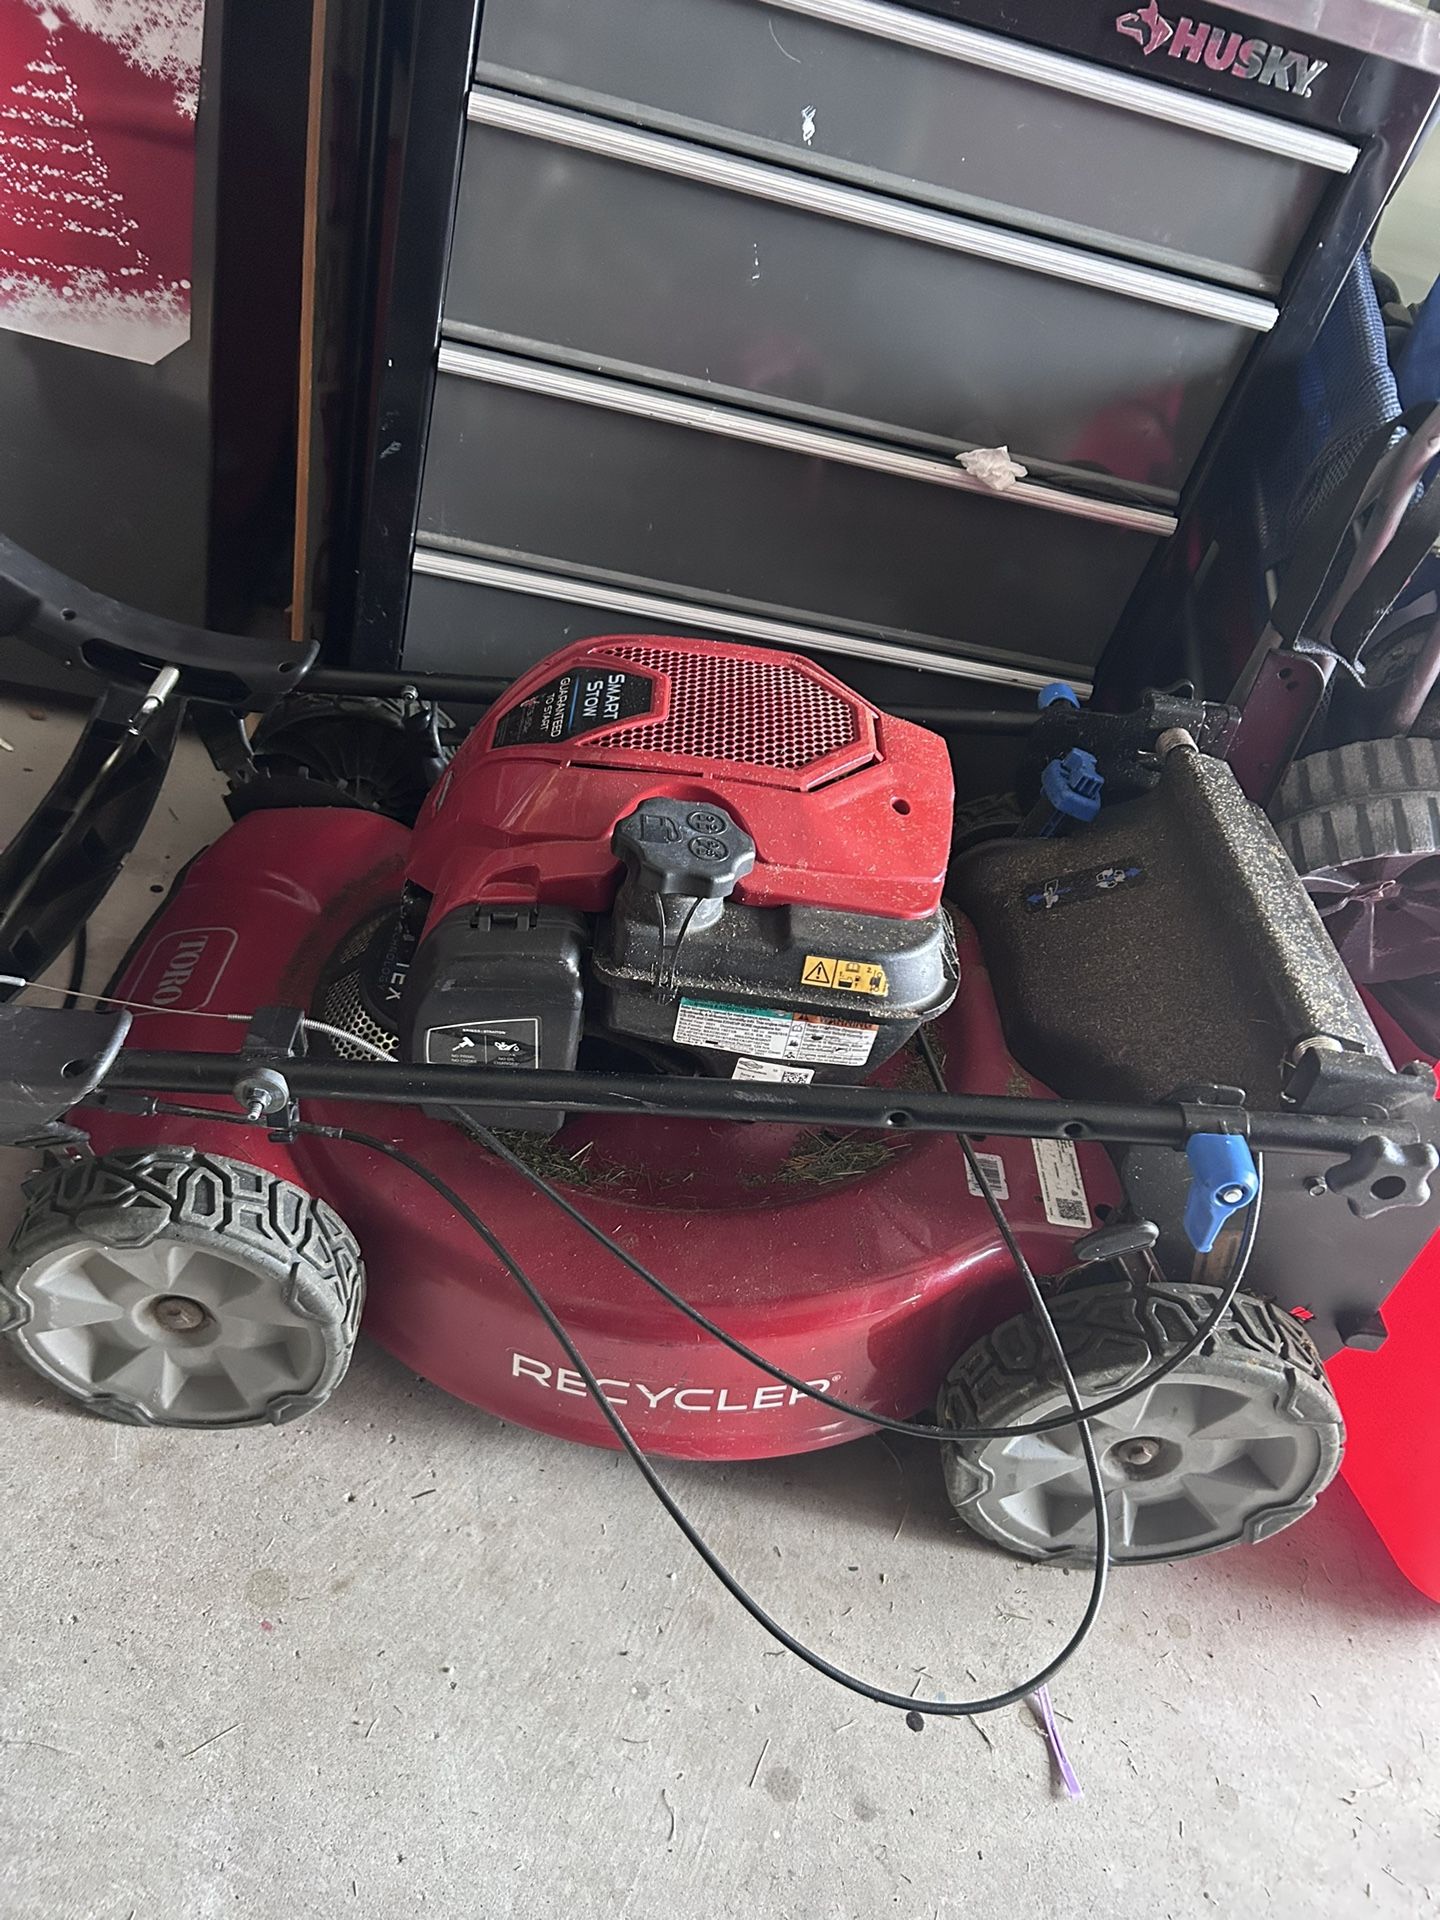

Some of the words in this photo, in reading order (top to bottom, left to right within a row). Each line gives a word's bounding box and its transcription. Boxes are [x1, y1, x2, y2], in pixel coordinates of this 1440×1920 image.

[1168, 16, 1328, 98] HUSKY
[539, 704, 553, 732] START
[545, 693, 556, 705] TO
[550, 677, 571, 738] GUARANTEED
[582, 680, 604, 718] STOW
[603, 673, 626, 720] SMART
[152, 935, 209, 1006] TORO
[511, 1352, 830, 1412] RECYCLER
